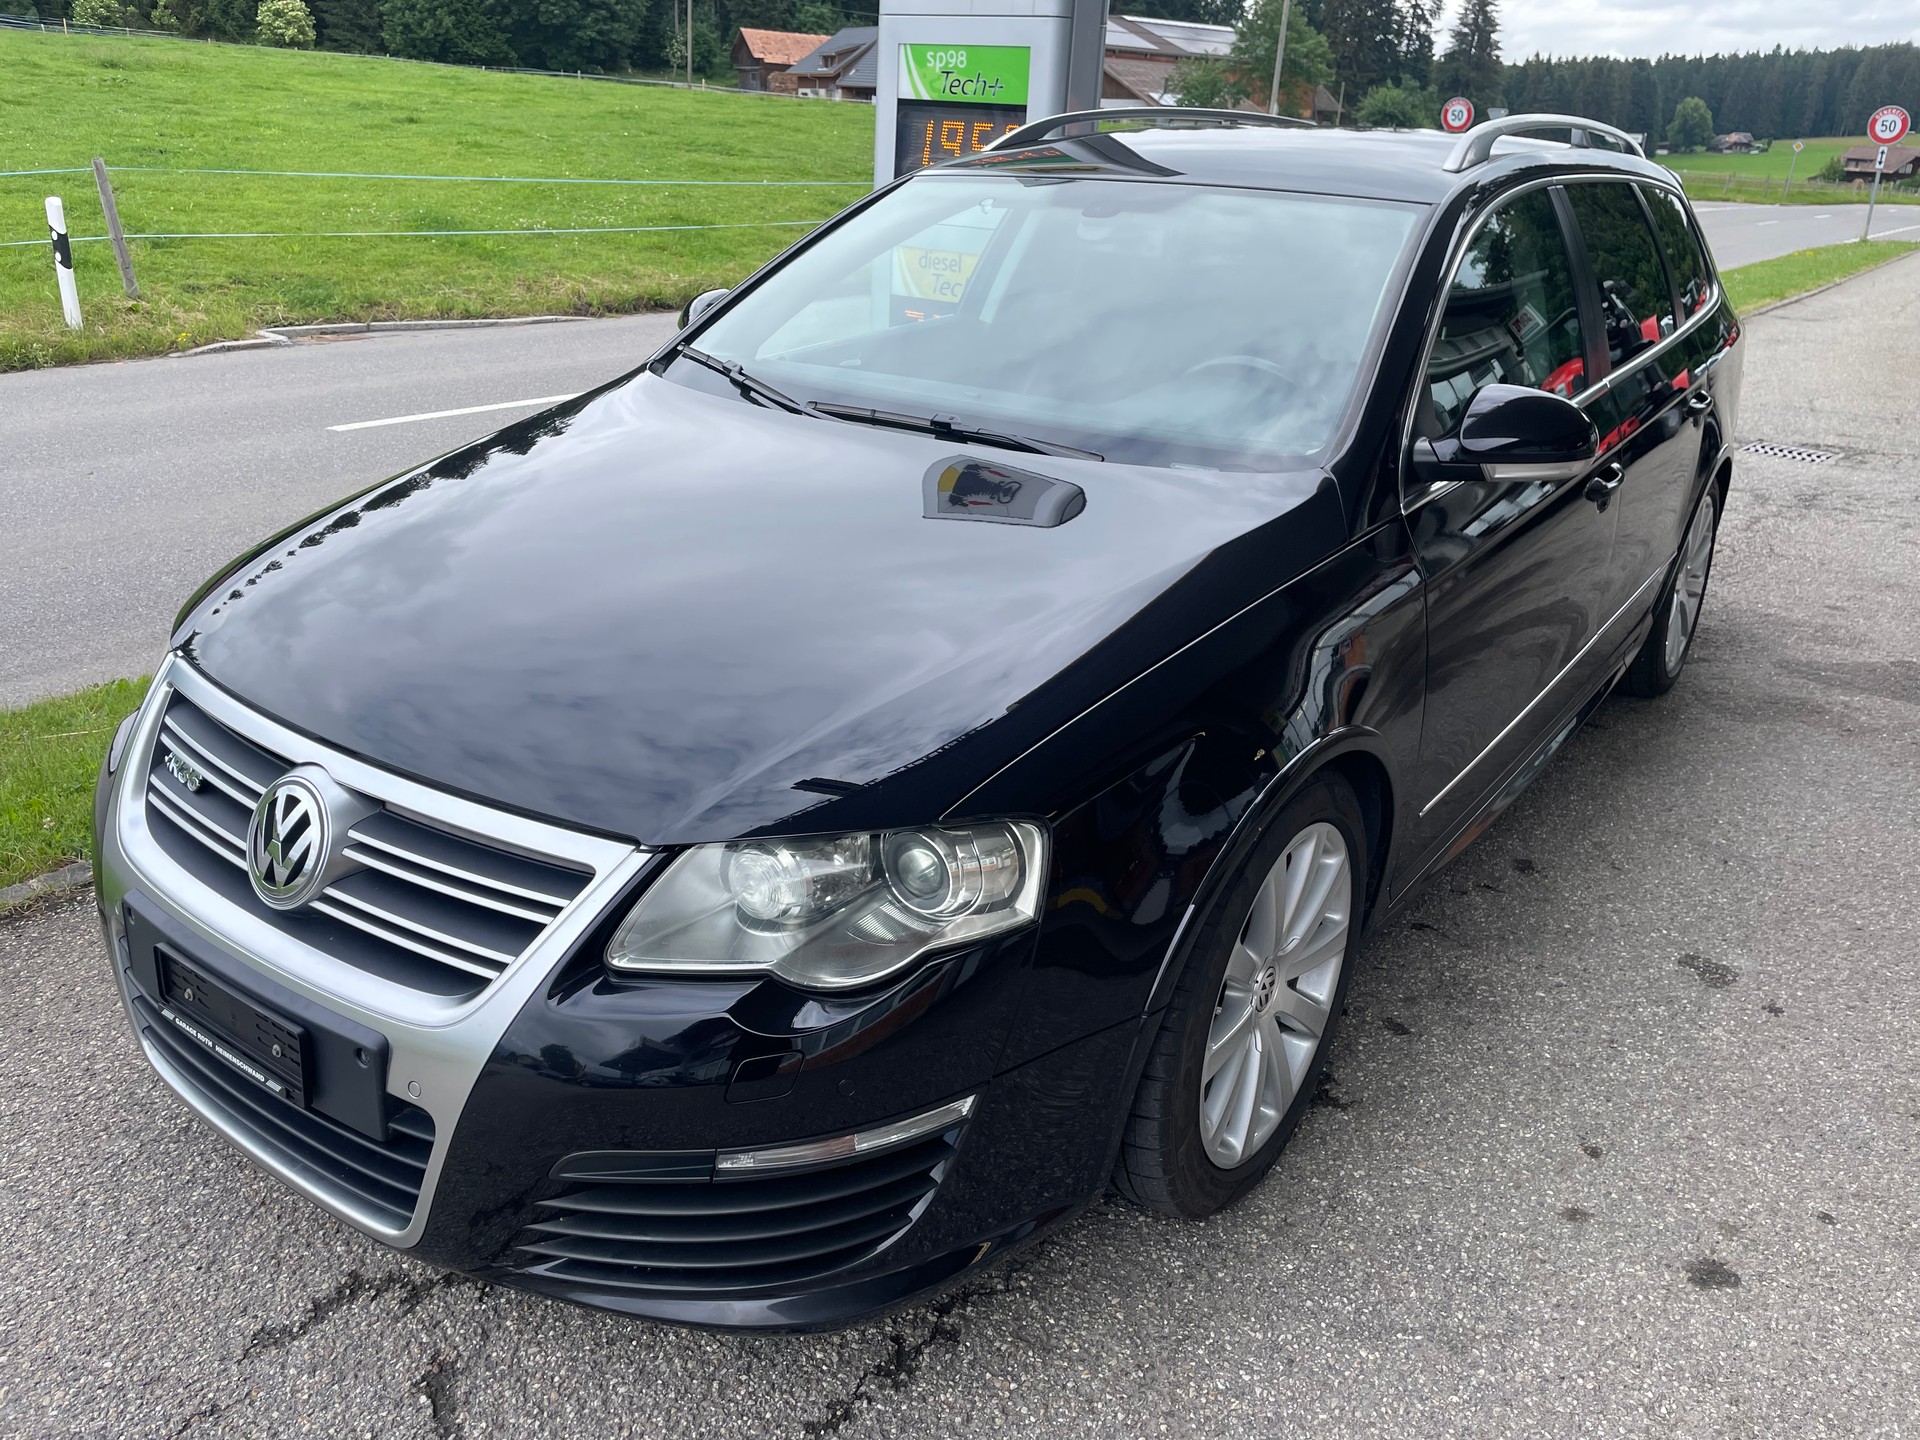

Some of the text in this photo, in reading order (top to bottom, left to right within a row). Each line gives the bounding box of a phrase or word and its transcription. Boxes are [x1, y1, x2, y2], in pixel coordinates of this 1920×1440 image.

[926, 50, 967, 71] sp98
[940, 71, 1004, 97] Tech+
[1451, 109, 1464, 122] 50
[1880, 119, 1897, 132] 50
[922, 119, 1020, 167] 195
[918, 250, 962, 273] diesel
[175, 1018, 265, 1082] GARAGE ROTH HEIMENSCHWAND
